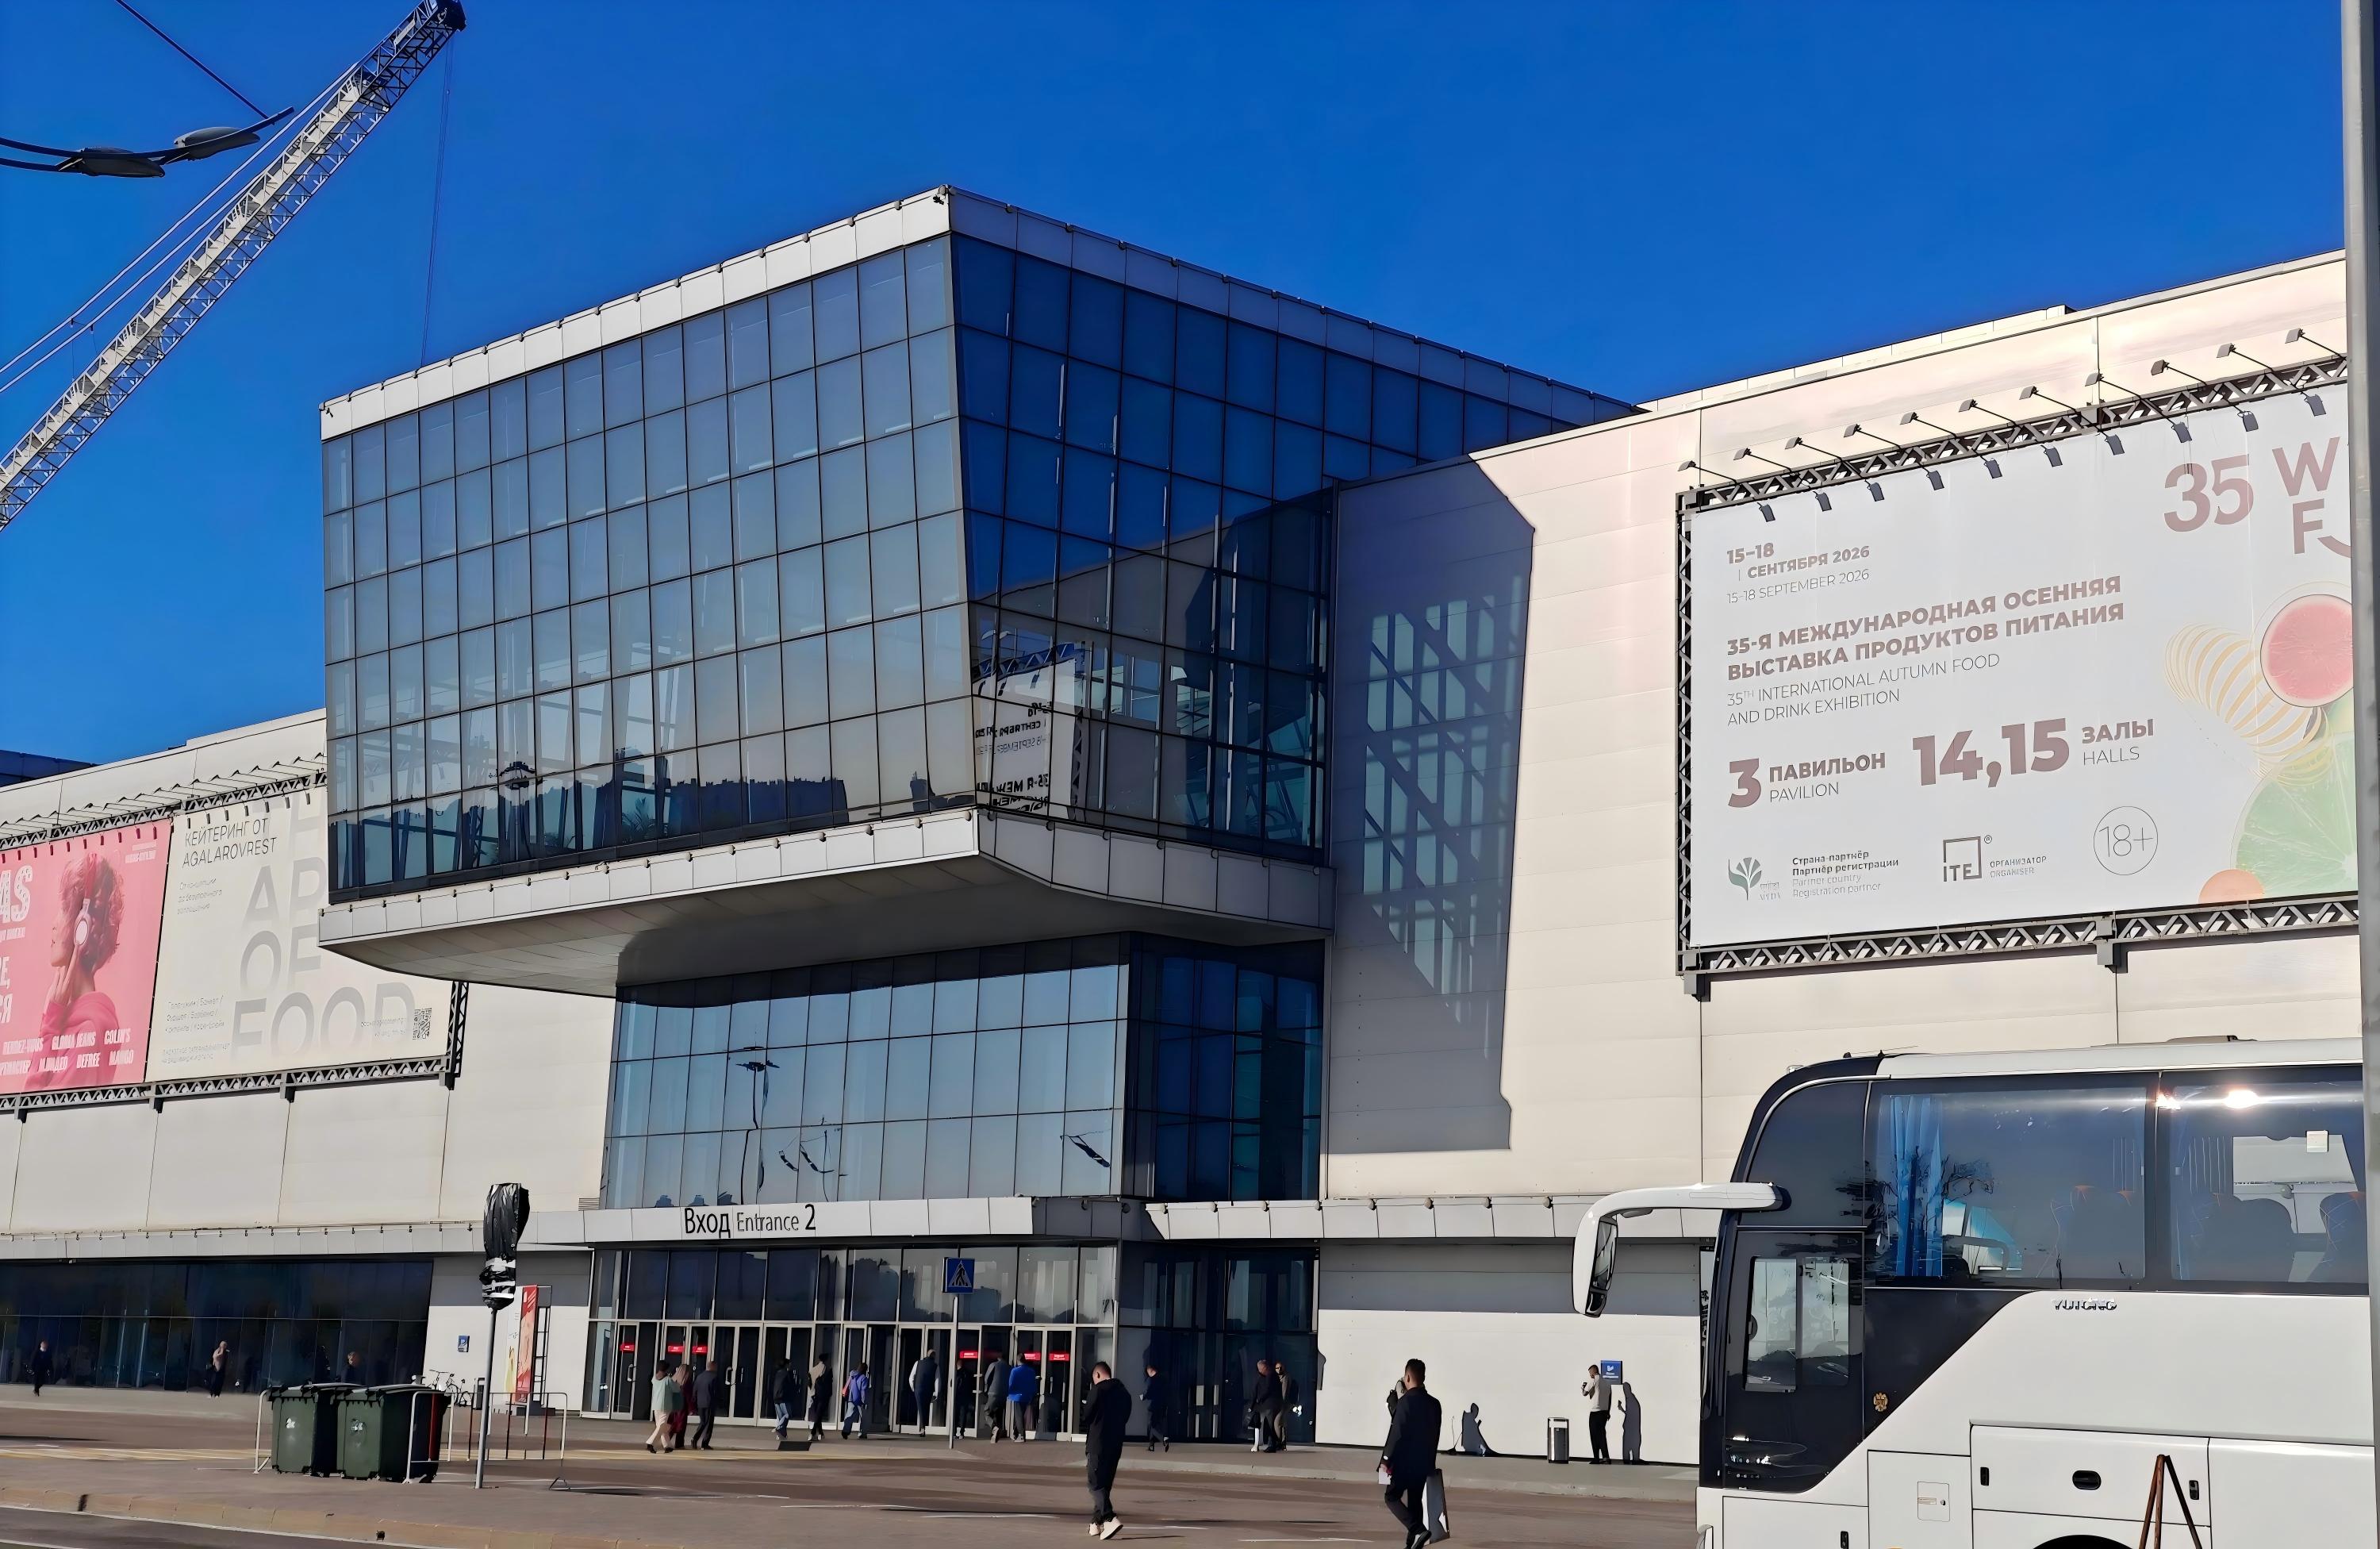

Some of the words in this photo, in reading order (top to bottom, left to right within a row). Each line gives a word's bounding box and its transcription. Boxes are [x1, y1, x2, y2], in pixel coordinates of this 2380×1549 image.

[2163, 454, 2254, 532] 35
[2271, 436, 2340, 496] W
[1726, 542, 1775, 564] 15-18
[1747, 553, 1828, 578] СЕНТЯБРЯ
[1833, 545, 1870, 563] 2026
[1726, 589, 1756, 603] 15-18
[1759, 575, 1836, 598] SEPTEMBER
[1839, 569, 1869, 584] 2026
[1727, 633, 1772, 655] 35-Я
[1778, 596, 1996, 648] МЕЖДУНАРОДНАЯ
[2003, 575, 2121, 609] ОСЕННЯЯ
[1728, 647, 1848, 681] ВЫСТАВКА
[1855, 623, 1998, 660] ПРОДУКТОВ
[2006, 602, 2124, 636] ПИТАНИЯ
[1759, 674, 1875, 702] INTERNATIONAL
[1879, 661, 1947, 683] AUTUMN
[1952, 652, 2000, 672] FOOD
[1727, 710, 1760, 726] AND
[1764, 702, 1810, 721] DRINK
[1815, 689, 1900, 713] EXHIBITION
[2082, 719, 2154, 744] ЗАЛЫ
[1769, 752, 1886, 782] ПАВИЛЬОН
[1912, 718, 2070, 788] 14,15
[2083, 746, 2140, 766] HALLS
[1728, 758, 1761, 808] 3
[1769, 782, 1839, 803] PAVILION
[185, 821, 250, 847] КЕЙТЕРИНГ
[253, 817, 269, 835] ОТ
[2098, 824, 2154, 857] 18+
[182, 837, 277, 868] AGALAROVREST
[1792, 850, 1869, 867] Страна-партнёр
[1792, 866, 1833, 877] Партнёр
[1836, 859, 1898, 874] регистрации
[1990, 855, 2047, 868] ОРГАНИЗАТОР
[232, 982, 416, 1059] FOOD
[685, 1207, 731, 1239] Вход
[737, 1212, 799, 1232] Entrance
[804, 1204, 816, 1230] 2
